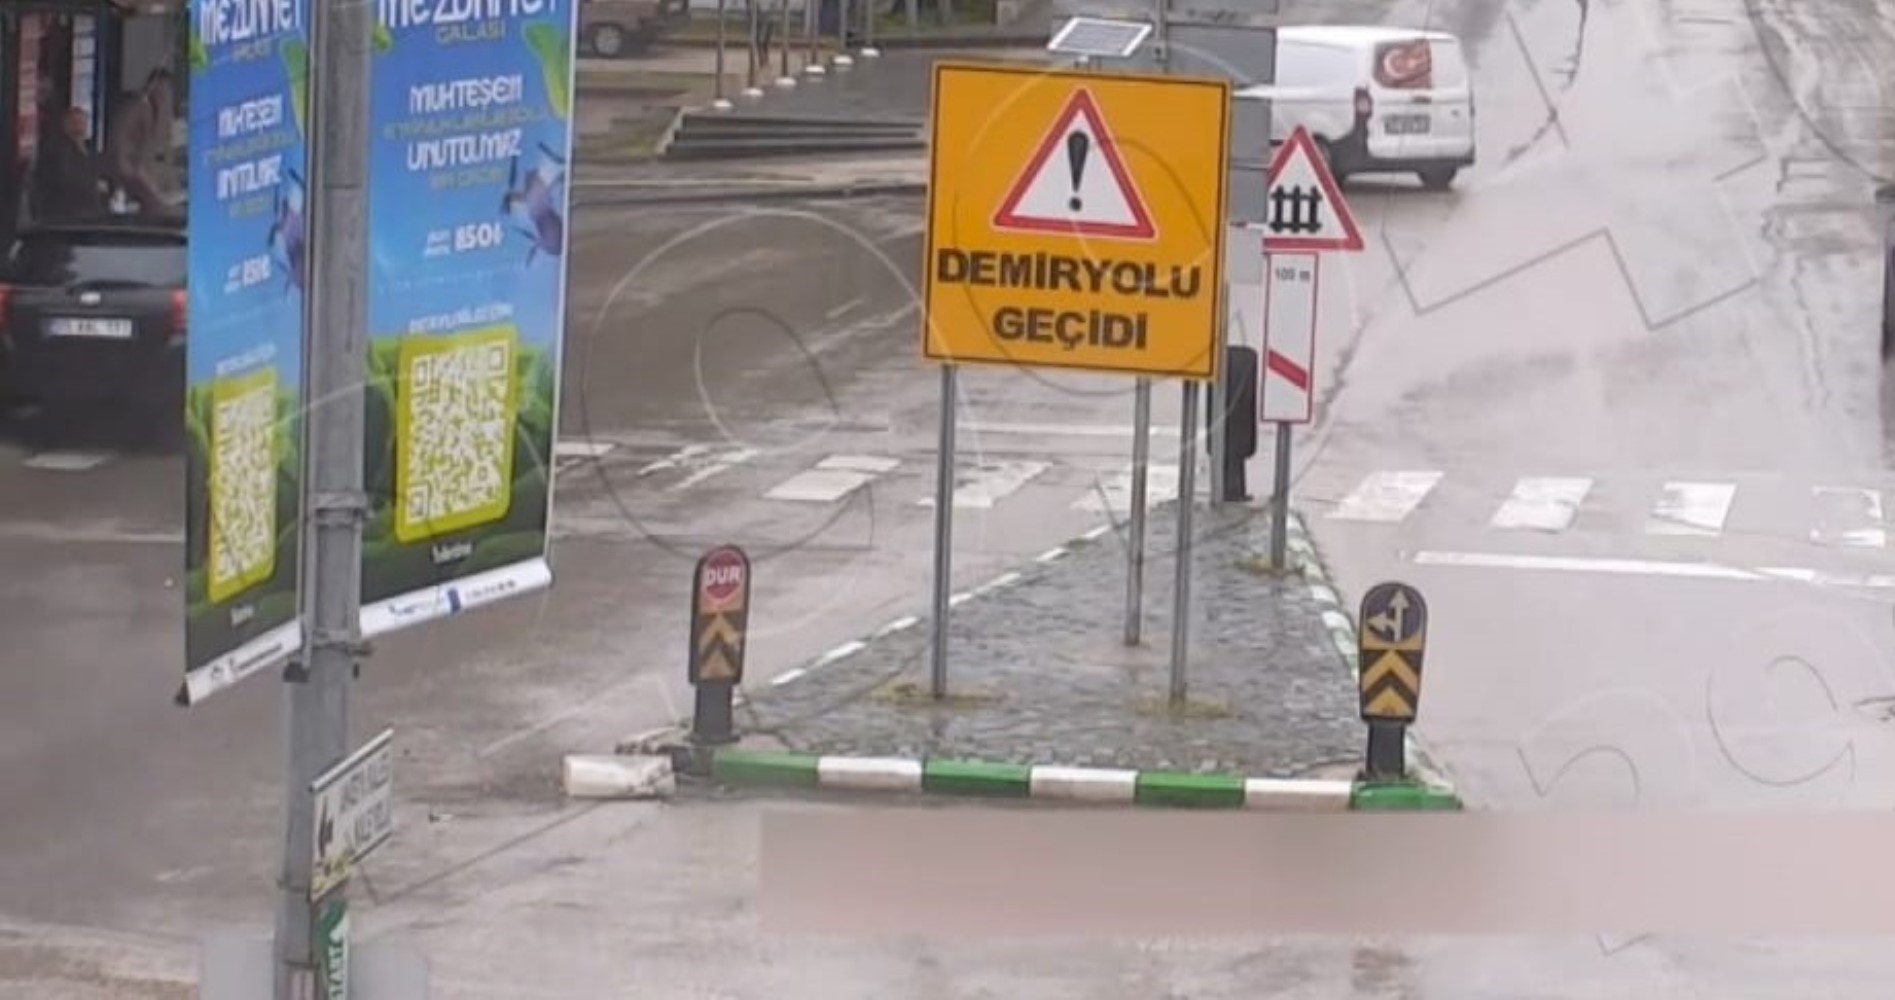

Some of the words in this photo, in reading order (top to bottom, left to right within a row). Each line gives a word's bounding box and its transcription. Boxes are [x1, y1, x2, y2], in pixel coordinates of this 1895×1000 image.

[937, 248, 1200, 298] DEMİRYOLU
[992, 306, 1148, 350] GEÇİDİ
[705, 564, 742, 588] DUR
